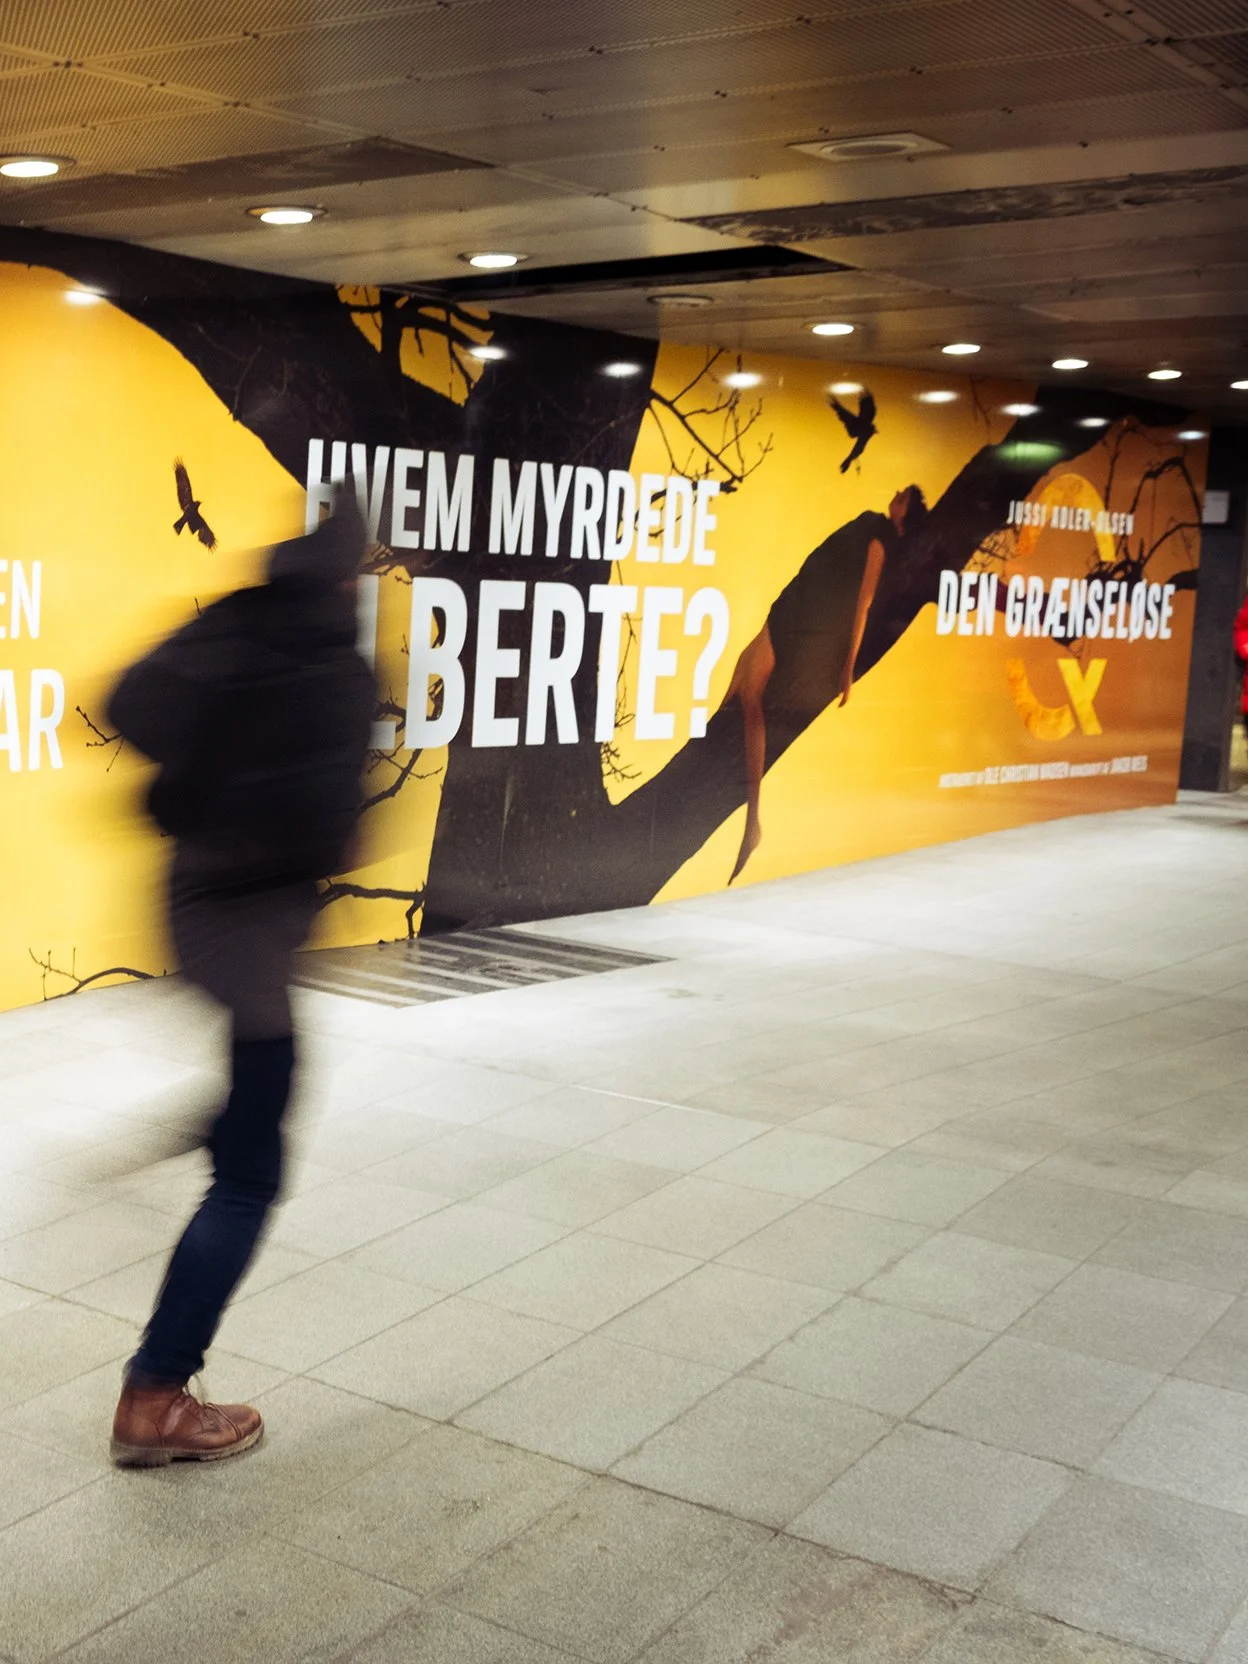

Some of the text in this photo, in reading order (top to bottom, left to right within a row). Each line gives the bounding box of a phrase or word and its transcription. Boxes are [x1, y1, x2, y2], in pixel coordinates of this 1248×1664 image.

[305, 438, 721, 566] HVEM MYRDEDE
[1007, 500, 1135, 536] JUSSI ADLER-OLSEN
[936, 569, 1176, 643] DEN GRÆNSELØSE
